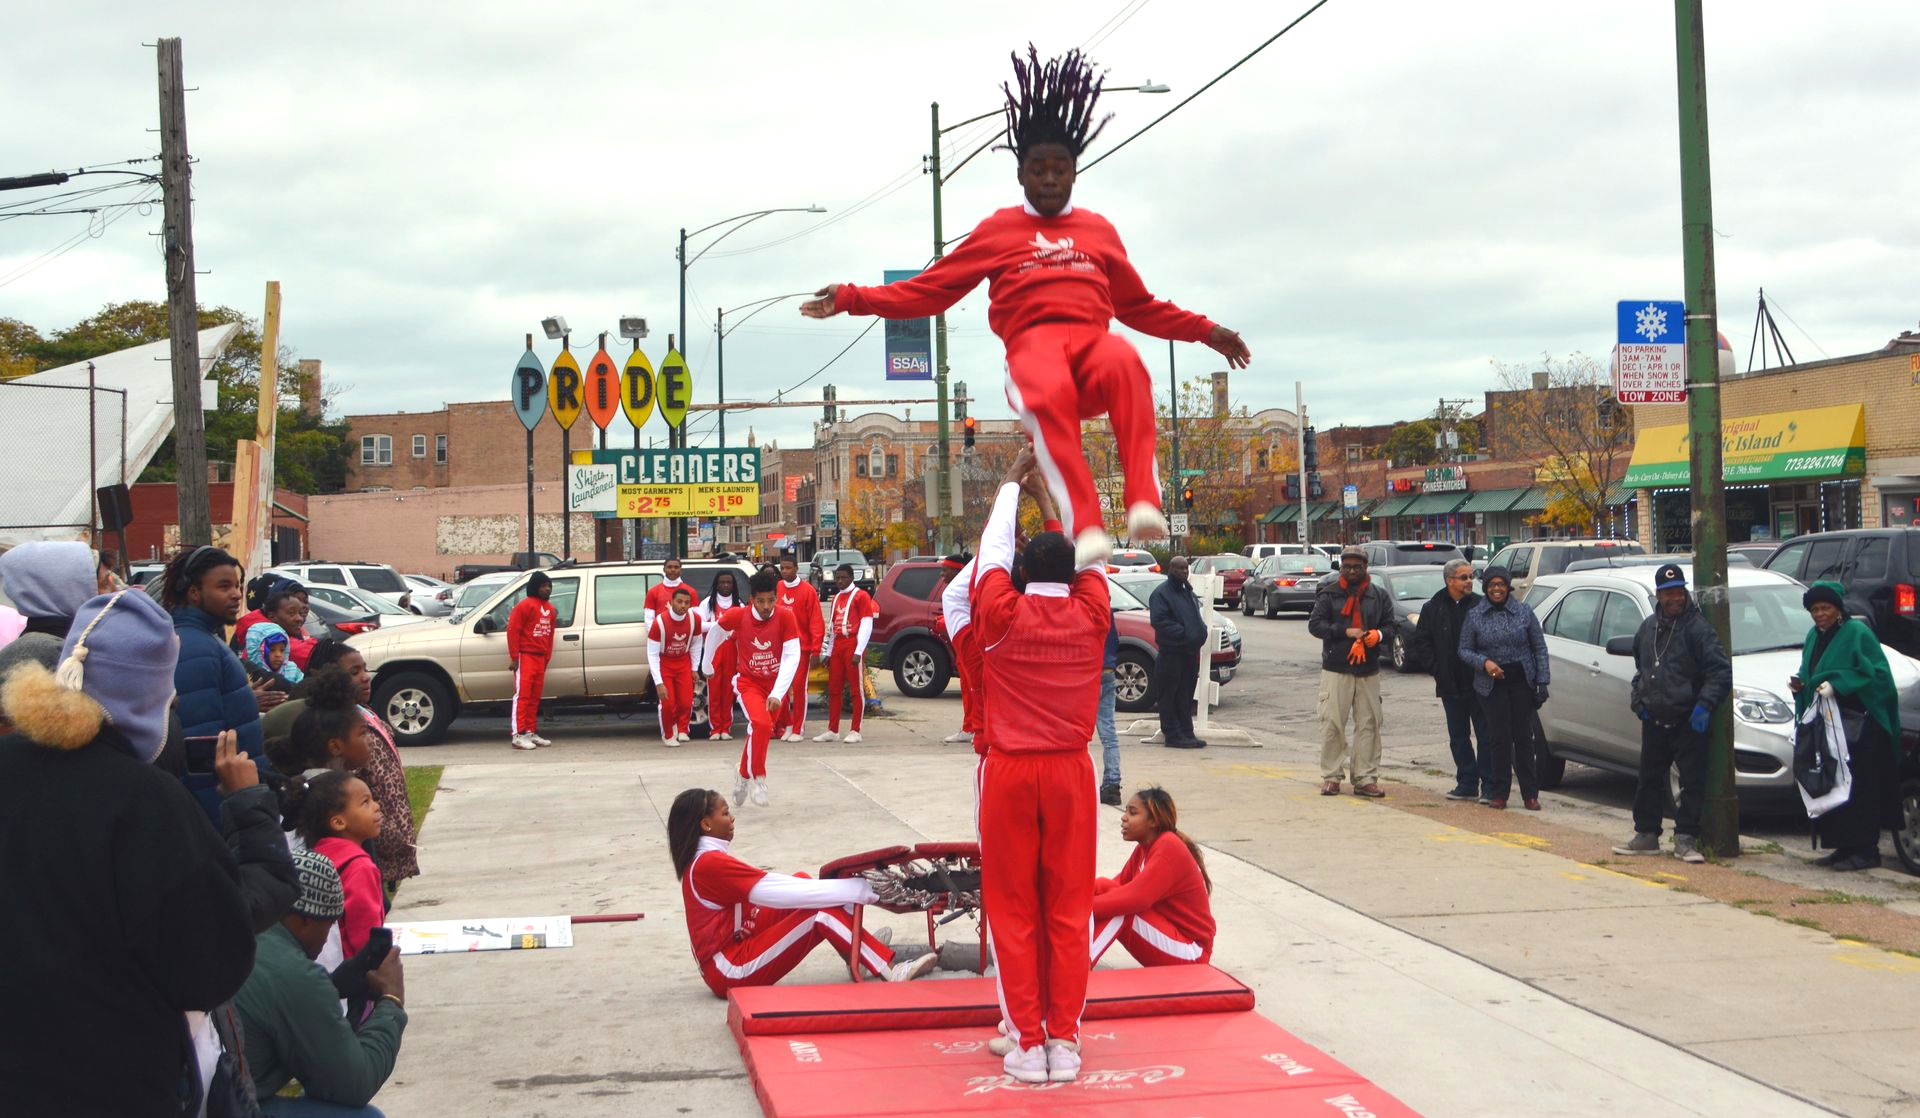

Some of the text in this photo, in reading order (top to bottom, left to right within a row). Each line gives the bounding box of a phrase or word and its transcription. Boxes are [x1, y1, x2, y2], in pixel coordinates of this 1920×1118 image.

[892, 357, 929, 373] SSA 51
[1622, 363, 1637, 371] DEC
[1670, 363, 1681, 371] OR
[1622, 391, 1681, 402] TOW ZONE
[1736, 430, 1783, 451] Island
[620, 453, 756, 484] CLEANERS
[1784, 454, 1846, 471] 773.224.7766
[574, 468, 609, 490] Shirts
[571, 473, 616, 509] Laundered
[621, 487, 684, 495] MOST GARMENTS
[1665, 569, 1675, 579] C
[306, 851, 335, 868] CHIC
[303, 860, 339, 880] CHICA
[298, 871, 343, 893] CHICA
[293, 899, 344, 916] CHICAG
